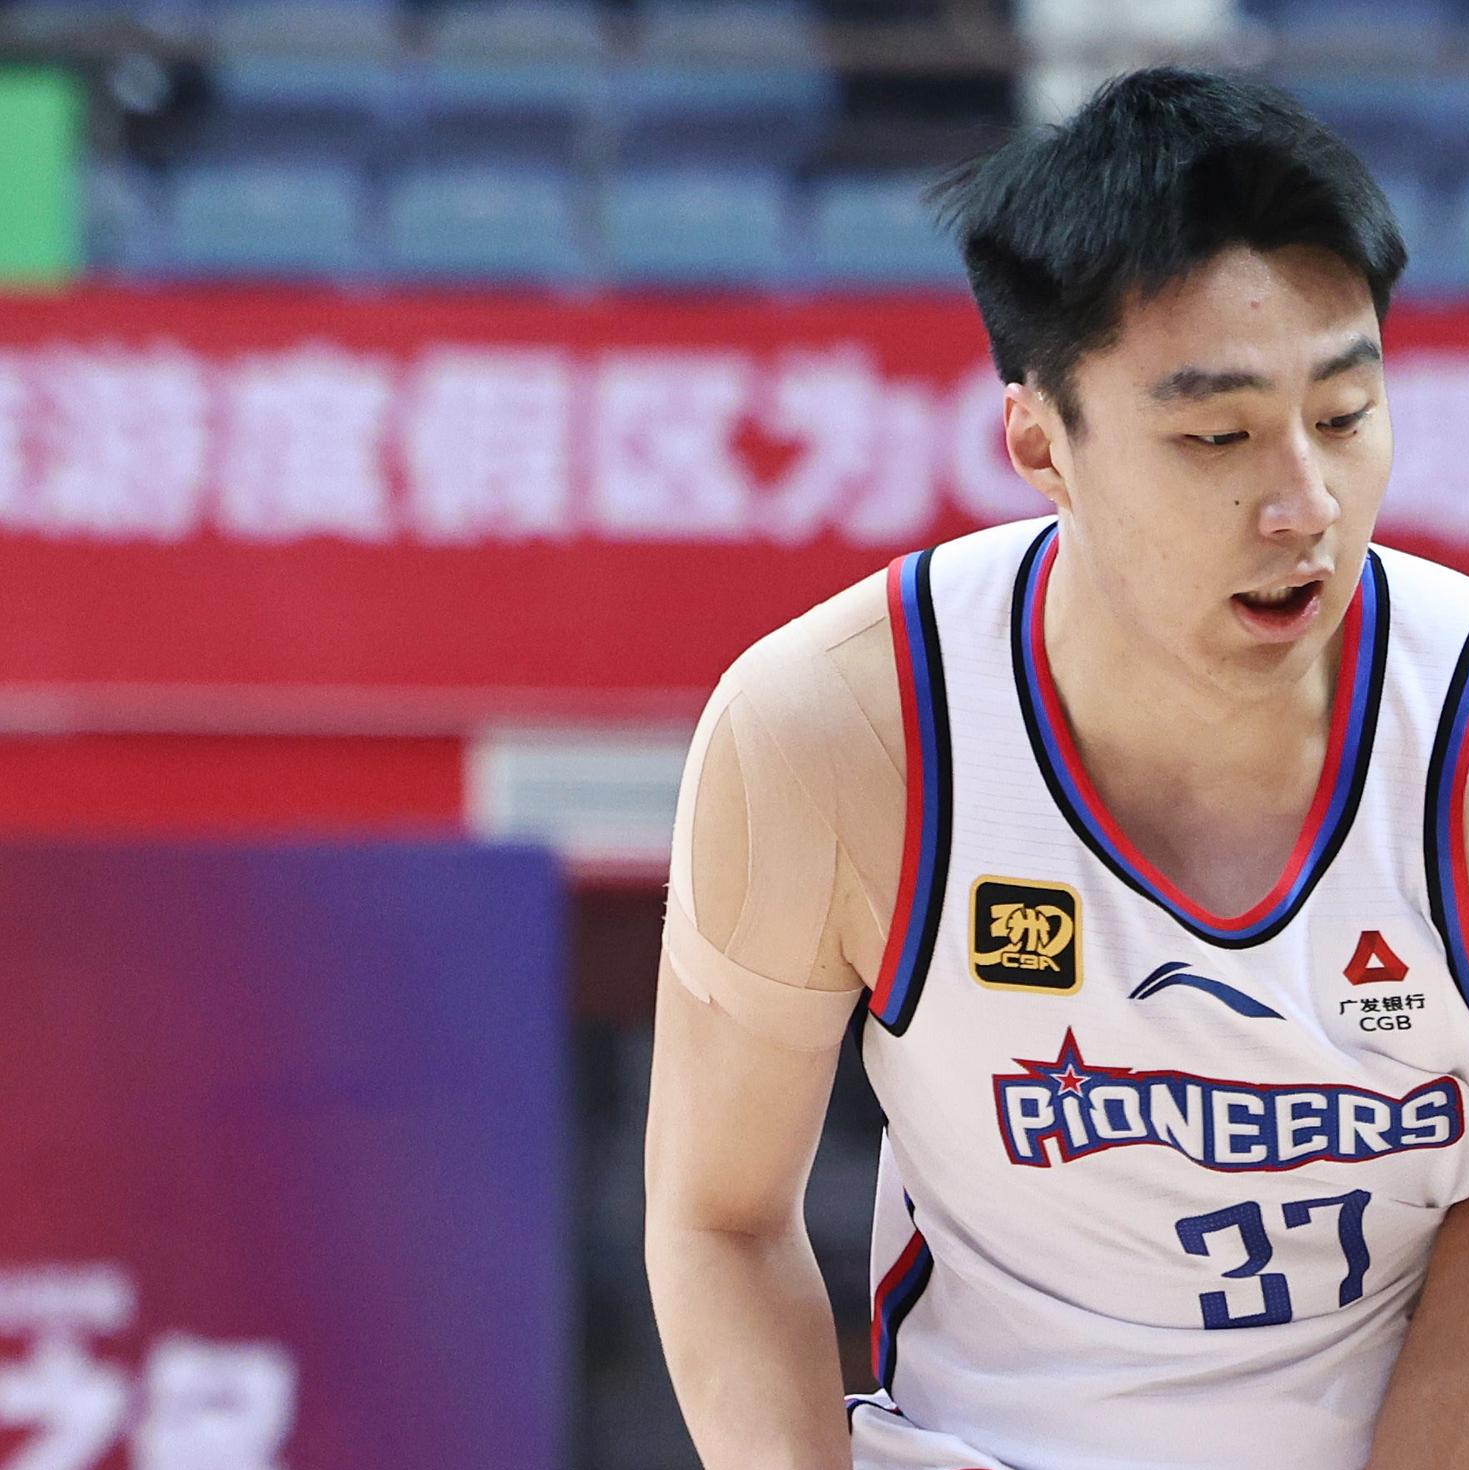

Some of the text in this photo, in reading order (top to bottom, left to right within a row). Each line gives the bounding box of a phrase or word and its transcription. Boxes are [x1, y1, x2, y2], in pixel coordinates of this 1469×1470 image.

[1339, 993, 1425, 1015] 广发银行
[1359, 1015, 1412, 1032] CGB
[1174, 1188, 1373, 1332] 37
